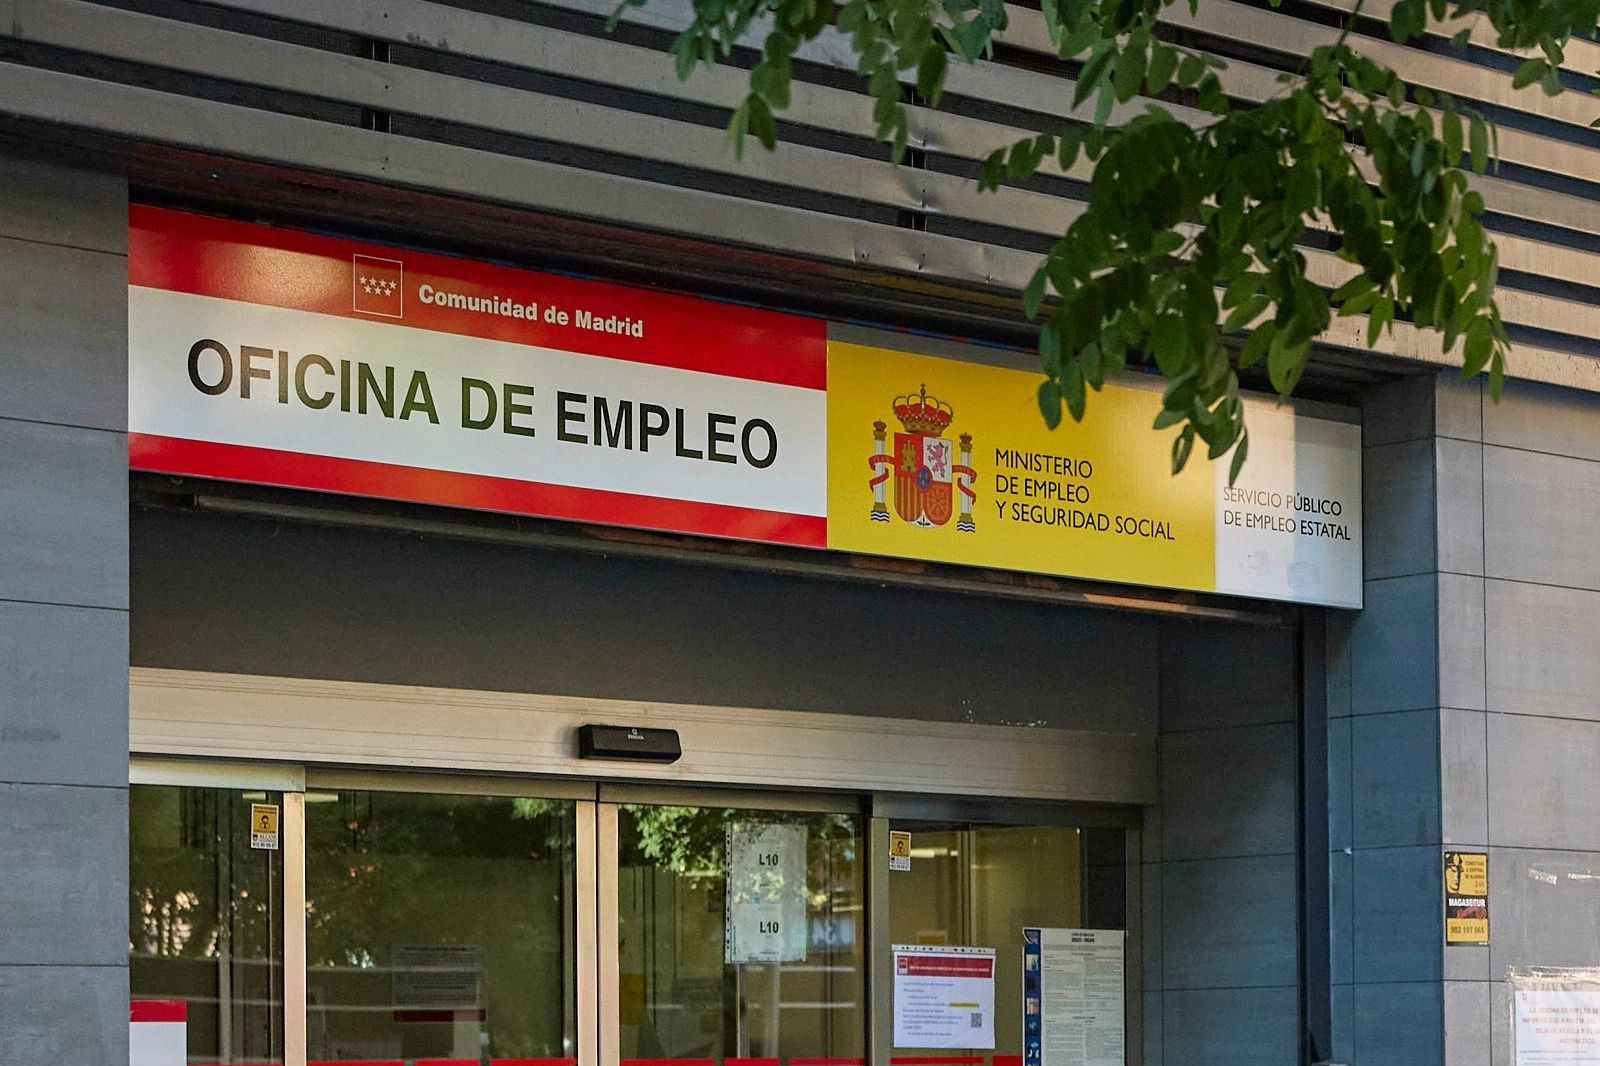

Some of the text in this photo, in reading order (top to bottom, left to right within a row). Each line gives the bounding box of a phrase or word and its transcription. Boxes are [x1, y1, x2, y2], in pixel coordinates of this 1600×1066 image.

[418, 284, 644, 338] Comunidad de Madrid
[187, 338, 778, 469] OFICINA DE EMPLEO
[995, 447, 1093, 479] MINISTERIO
[995, 474, 1090, 504] DE EMPLEO
[1223, 486, 1342, 516] SERVICIO PÚBLICO
[995, 500, 1175, 540] Y SEGURIDAD SOCIAL
[1224, 510, 1351, 541] DE EMPLEO ESTATAL
[759, 853, 779, 866] L10
[759, 921, 779, 934] L10
